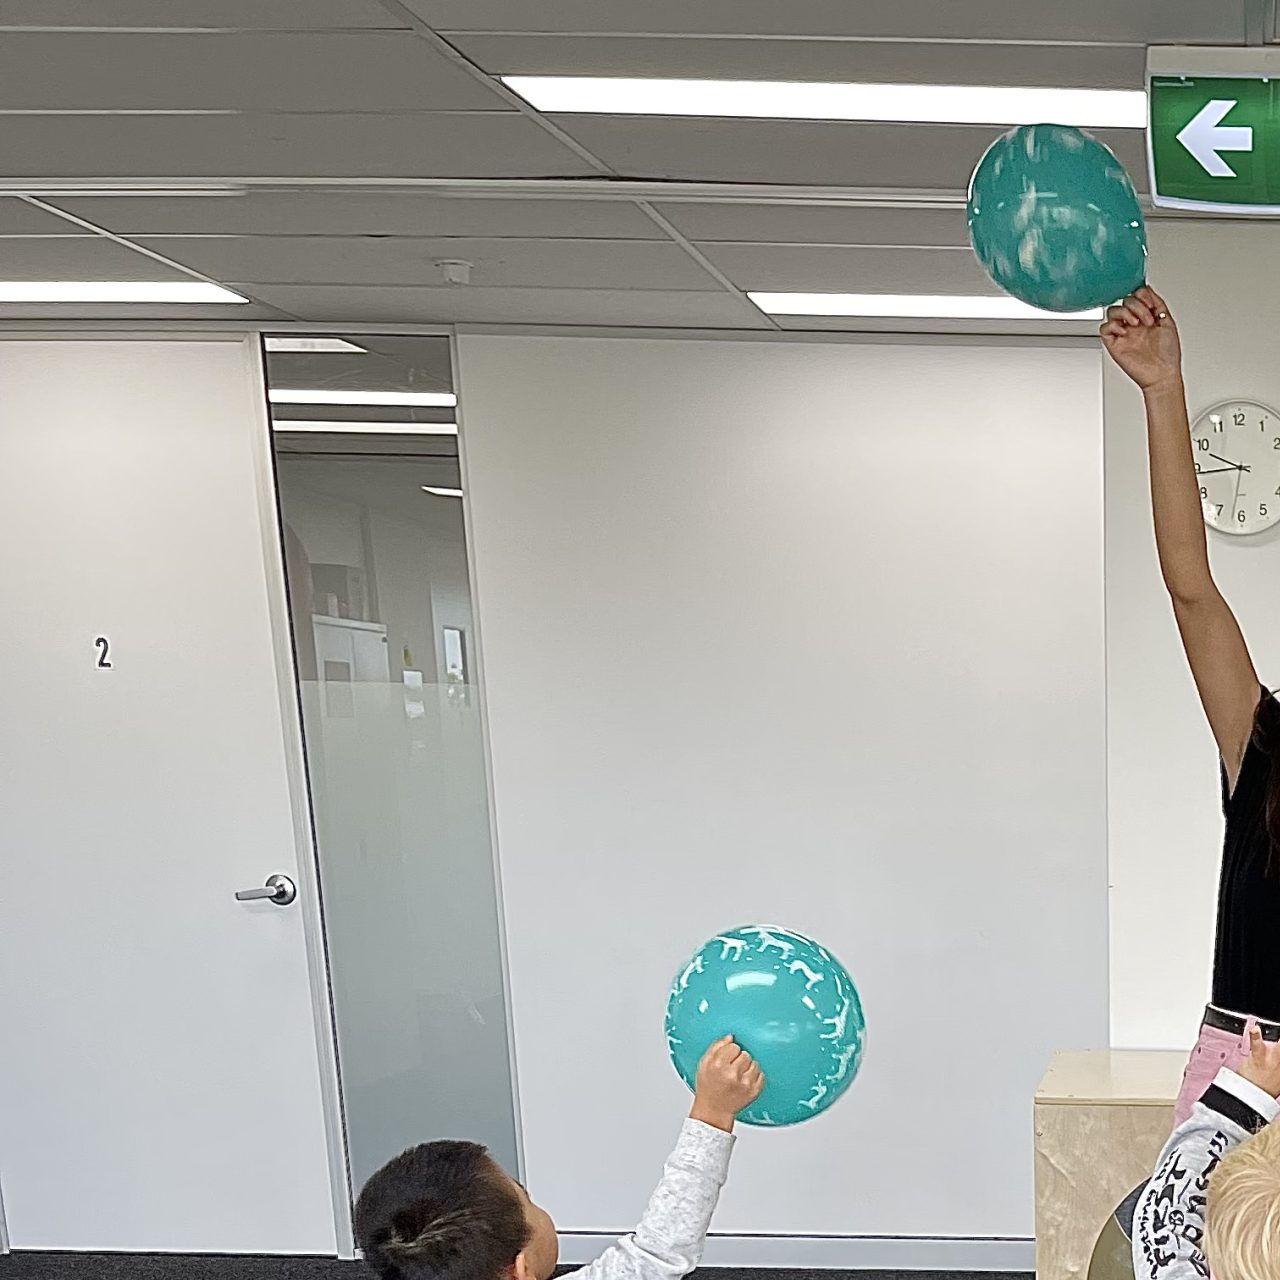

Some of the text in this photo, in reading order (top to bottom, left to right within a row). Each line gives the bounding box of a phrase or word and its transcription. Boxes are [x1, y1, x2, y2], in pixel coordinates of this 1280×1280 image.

[1232, 413, 1245, 426] 12
[1259, 420, 1264, 432] 1
[1213, 420, 1223, 433] 11
[1196, 438, 1209, 451] 10
[1200, 486, 1208, 499] 8
[1216, 504, 1224, 516] 7
[1259, 503, 1268, 516] 5
[1237, 510, 1246, 523] 6
[95, 637, 112, 668] 2
